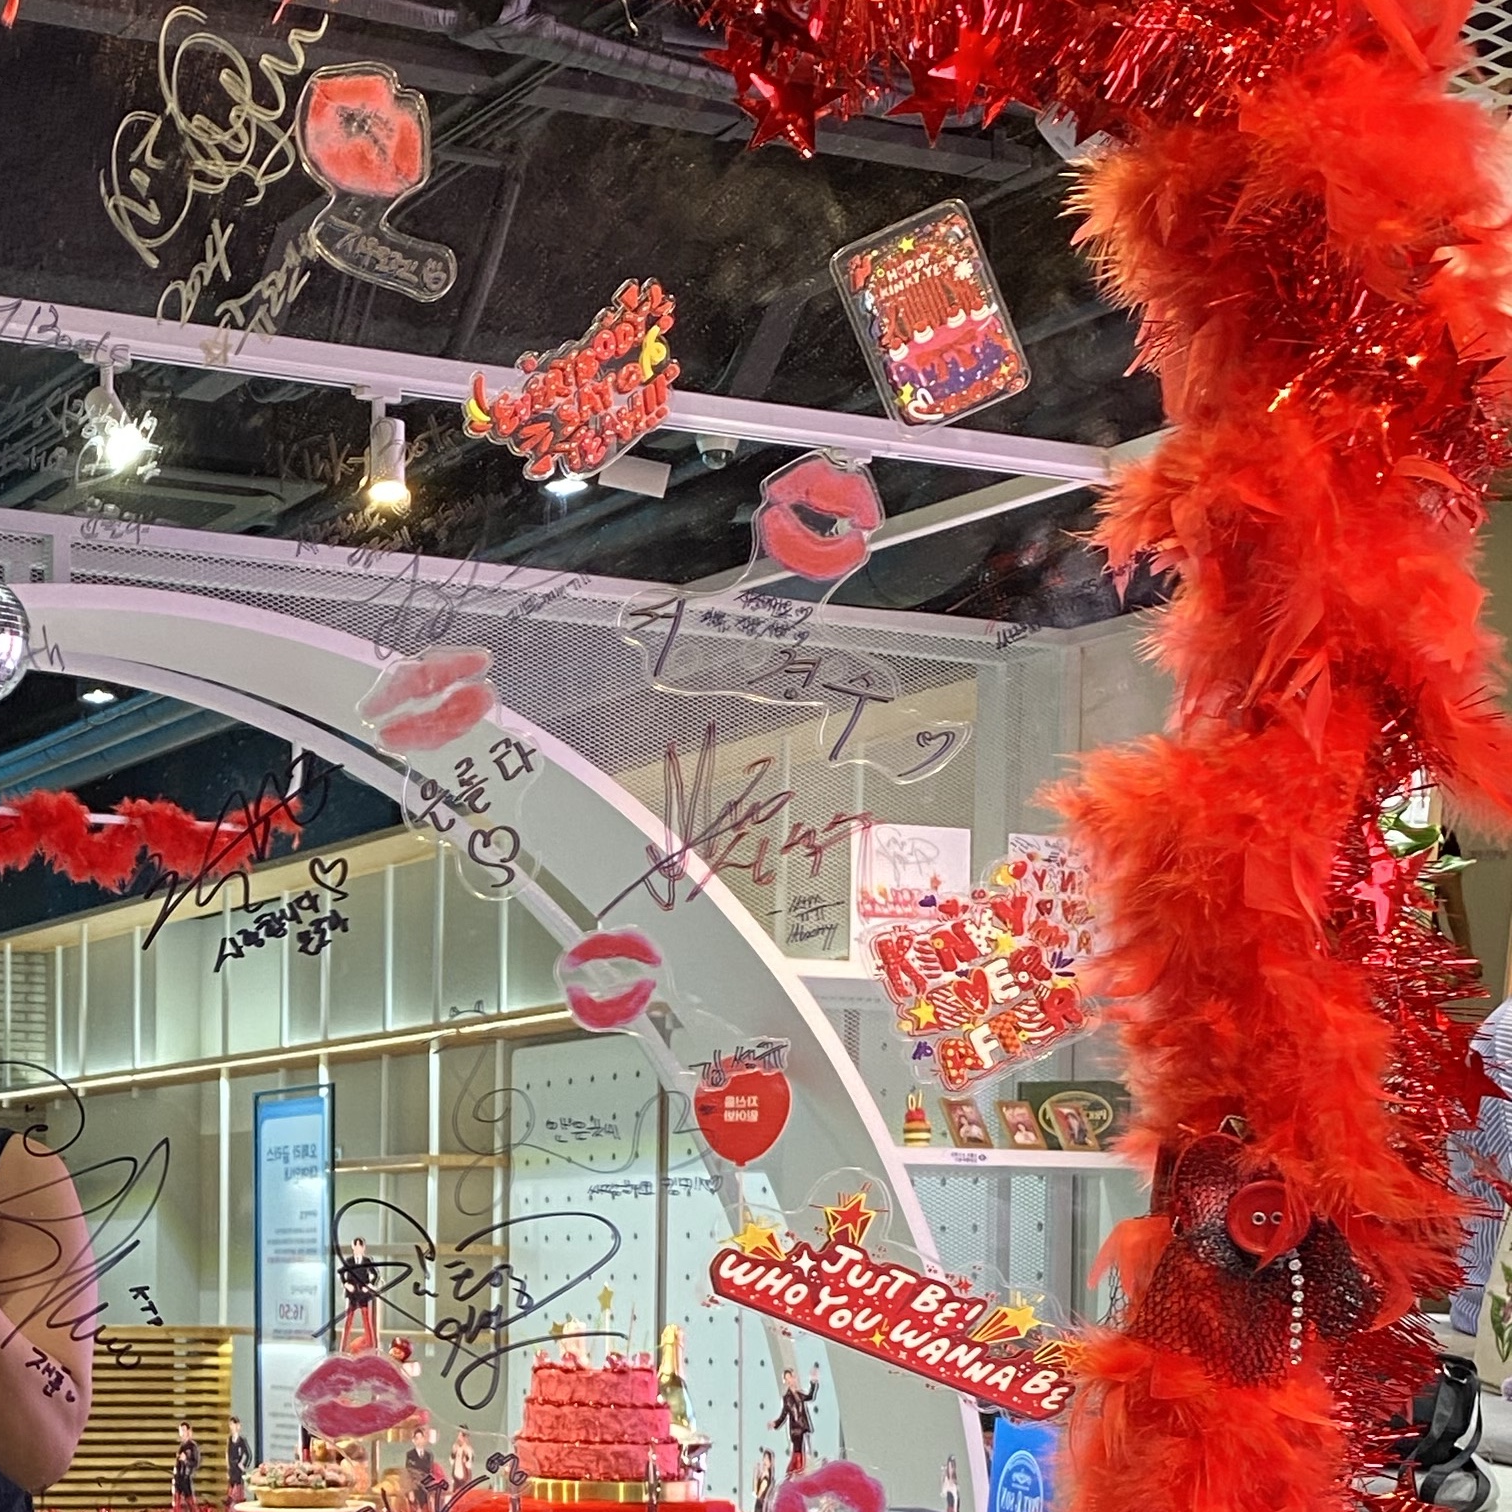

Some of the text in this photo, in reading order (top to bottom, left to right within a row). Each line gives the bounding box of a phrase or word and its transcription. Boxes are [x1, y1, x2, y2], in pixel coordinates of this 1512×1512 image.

[718, 1254, 1072, 1411] WHO YOU WANNA BE
[820, 1244, 984, 1331] JUST BE!
